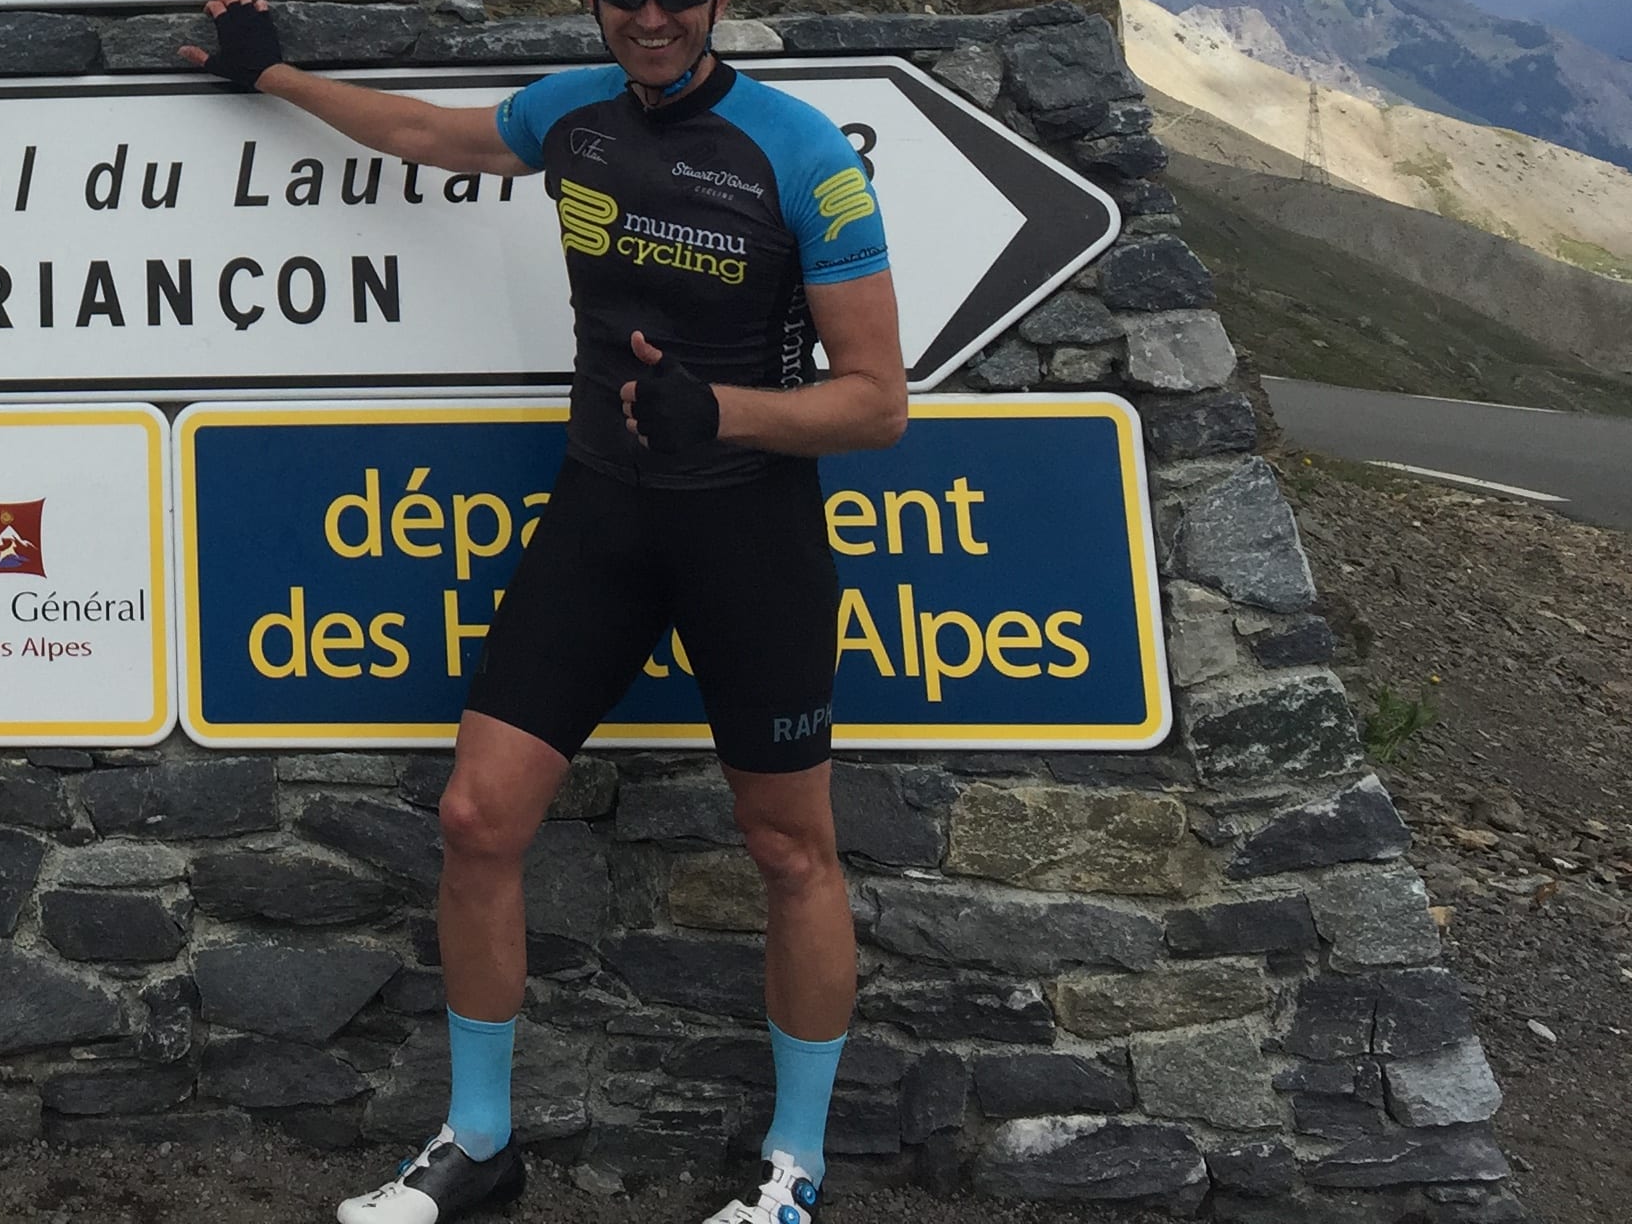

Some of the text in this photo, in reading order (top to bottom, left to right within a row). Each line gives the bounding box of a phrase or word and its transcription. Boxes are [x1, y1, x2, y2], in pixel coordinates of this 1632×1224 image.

[85, 143, 183, 211] du
[671, 161, 718, 182] Stuart
[623, 212, 747, 255] mummu
[616, 235, 749, 285] cycling
[11, 588, 145, 623] Général
[21, 636, 93, 662] Alpes
[248, 586, 410, 679] des
[835, 584, 1090, 702] Alpes
